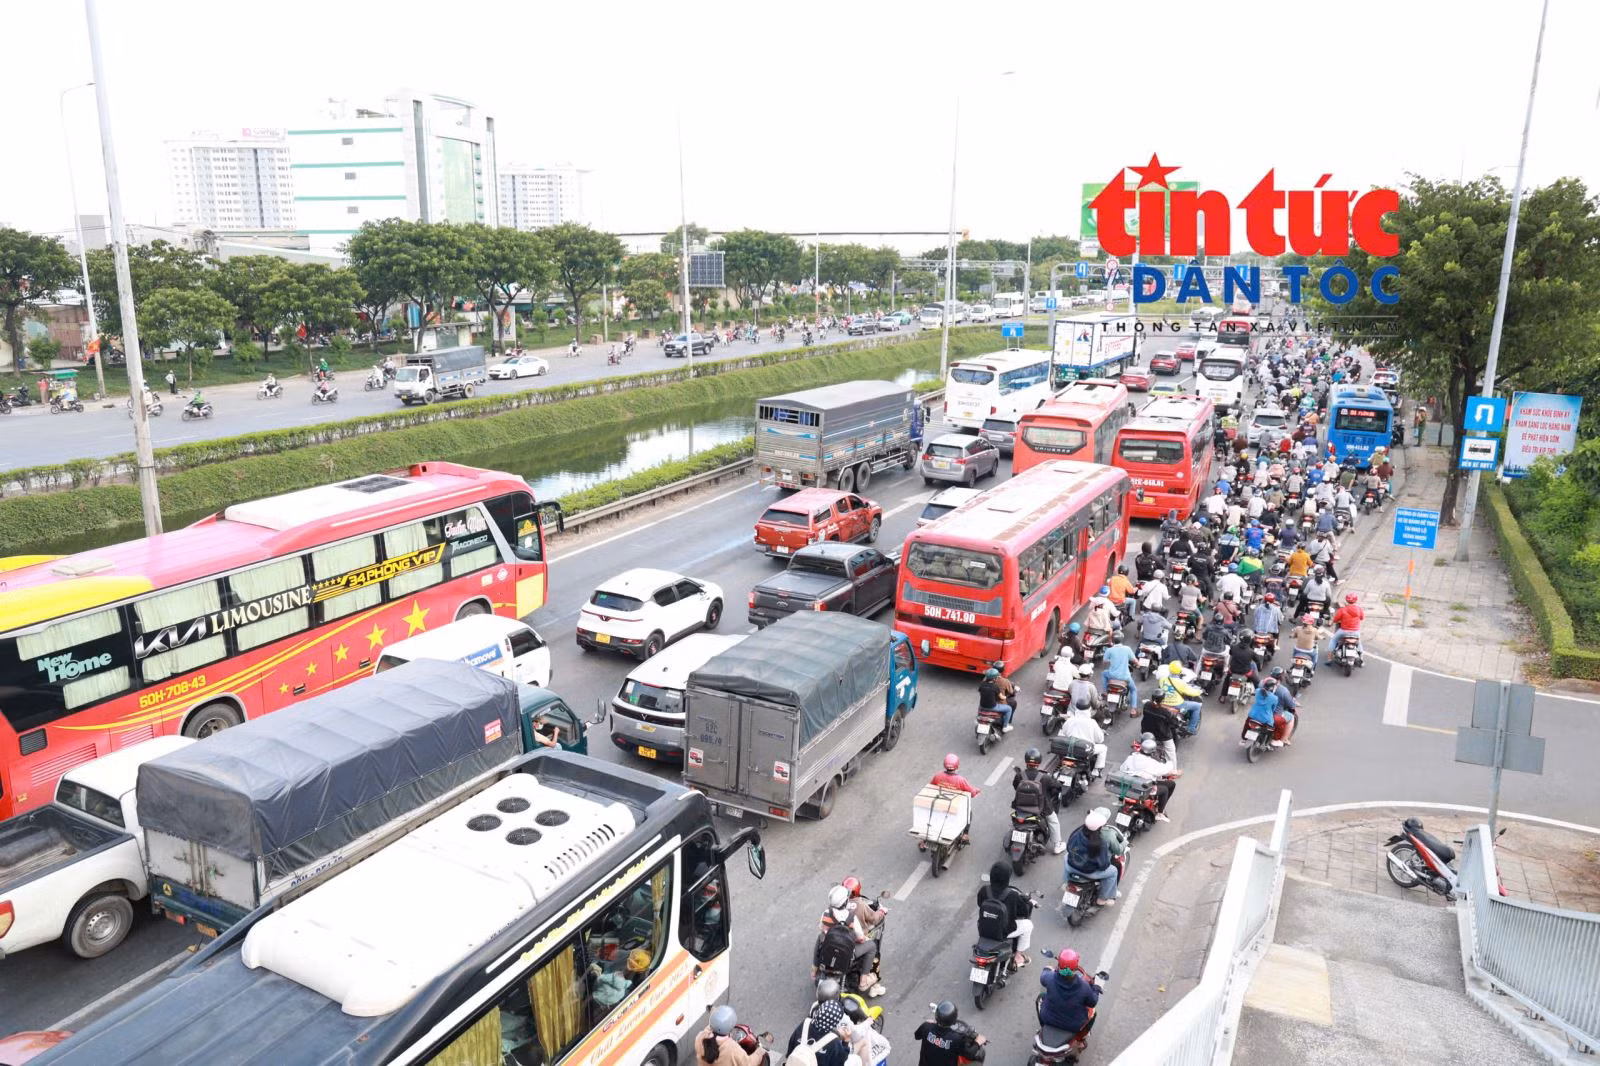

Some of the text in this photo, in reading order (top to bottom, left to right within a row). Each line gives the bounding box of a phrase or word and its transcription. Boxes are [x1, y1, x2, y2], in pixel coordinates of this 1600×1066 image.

[348, 573, 366, 587] 34
[412, 550, 436, 567] VIP
[210, 585, 312, 634] LIMOUSINE
[37, 652, 73, 672] New
[48, 652, 113, 683] Home
